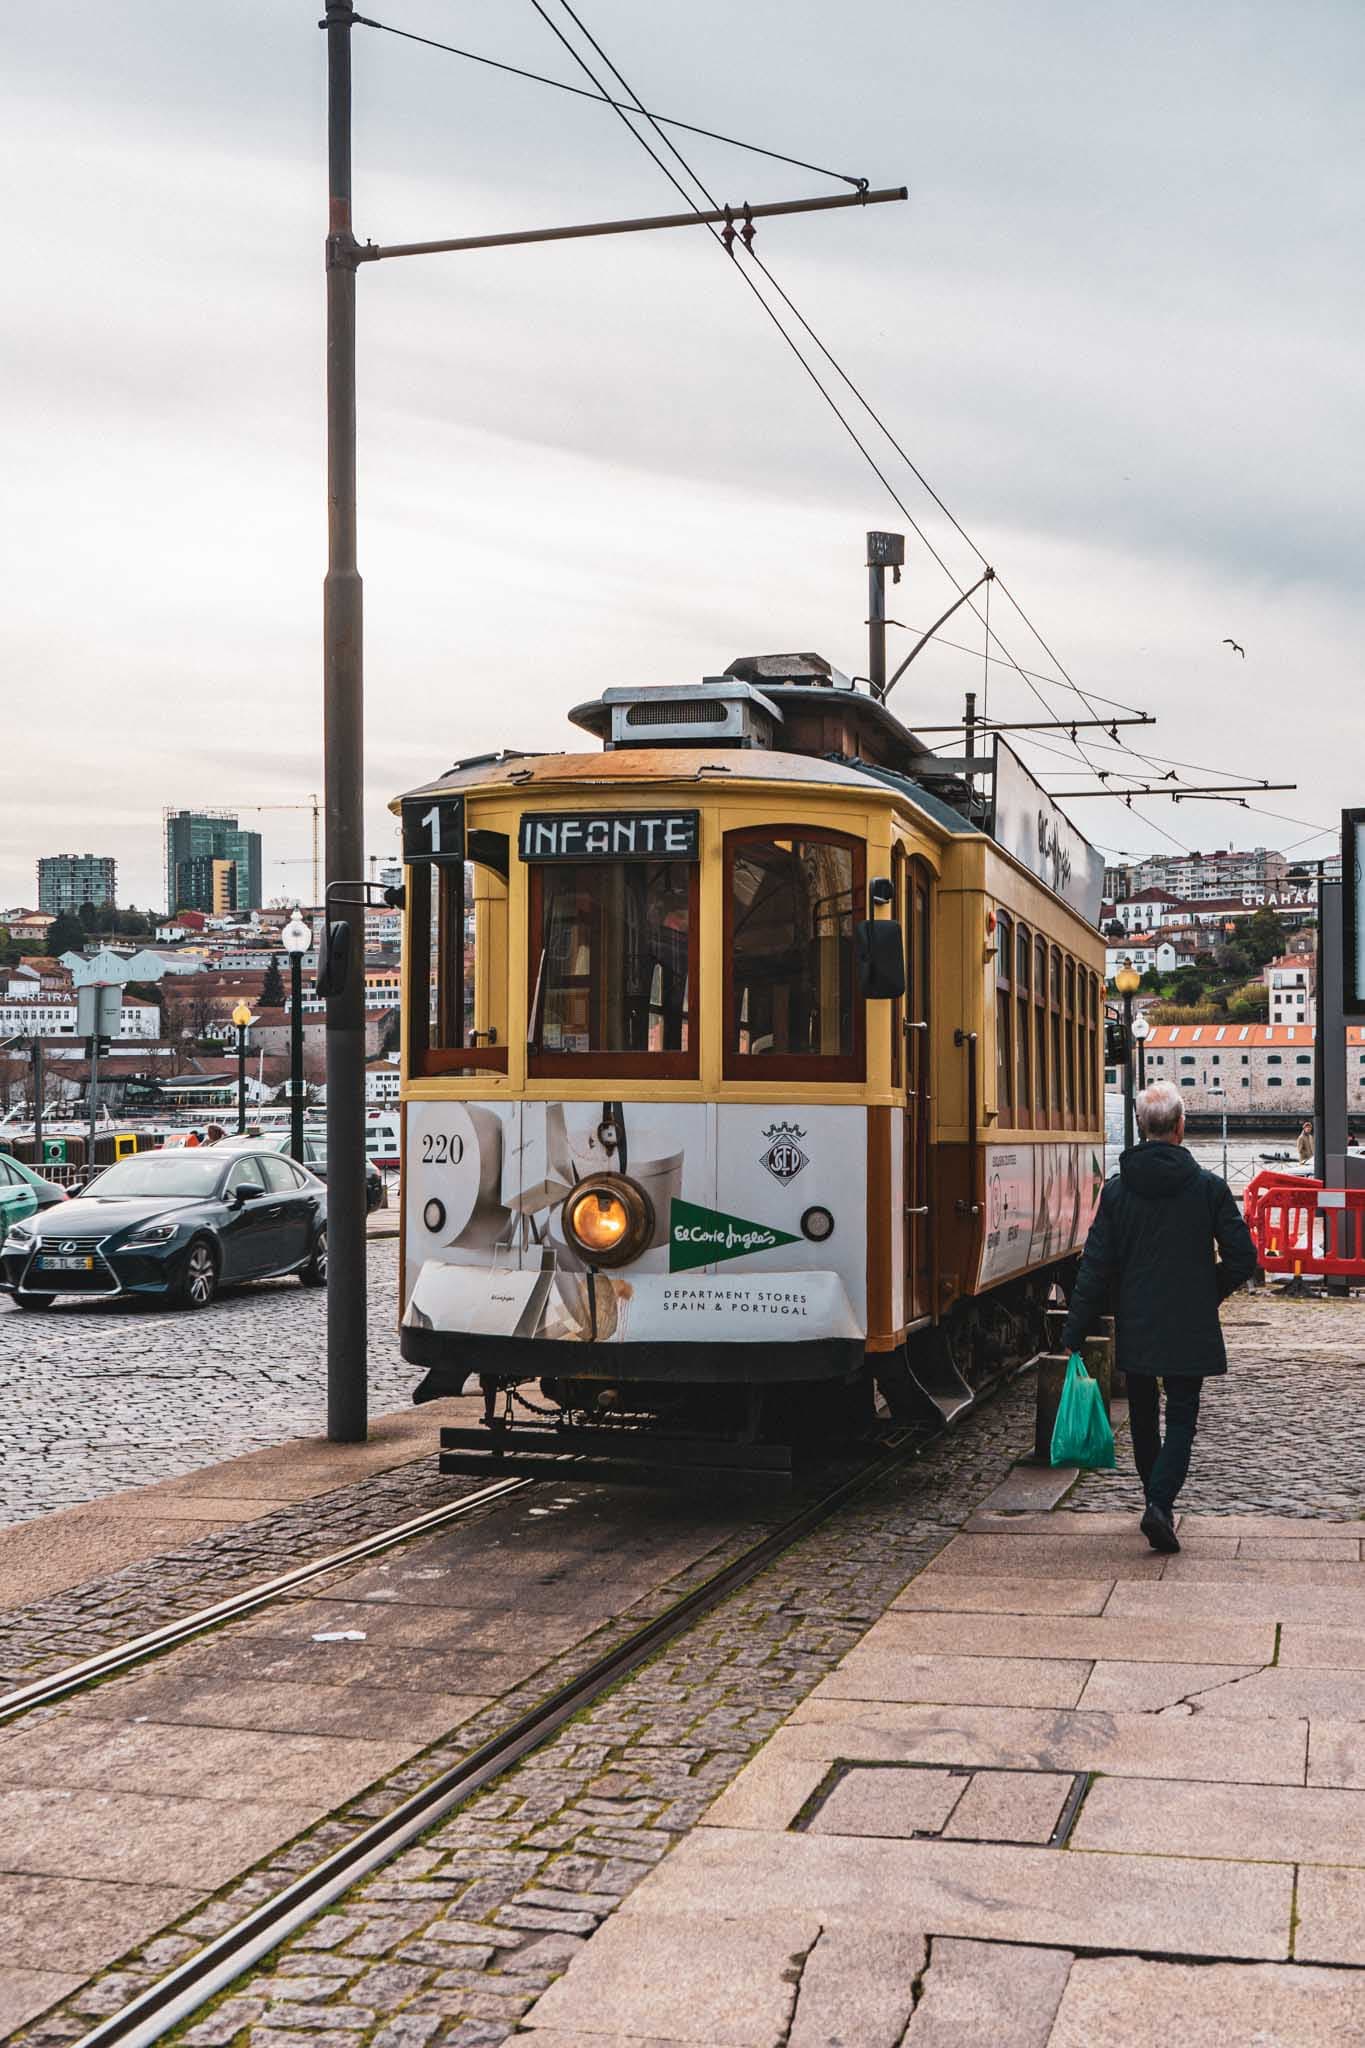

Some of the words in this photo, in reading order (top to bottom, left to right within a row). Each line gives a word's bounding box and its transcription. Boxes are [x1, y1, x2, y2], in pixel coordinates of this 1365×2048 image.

[422, 806, 441, 853] 1
[524, 818, 688, 854] INFANTE
[1242, 888, 1318, 906] GRAHAM
[422, 1134, 464, 1165] 220
[674, 1225, 690, 1241] El
[725, 1223, 776, 1249] Inglés
[663, 1302, 706, 1311] SPAIN
[714, 1303, 723, 1311] &
[731, 1303, 808, 1316] PORTUGAL
[664, 1290, 751, 1299] DEPARTMENT
[758, 1292, 807, 1303] STORES
